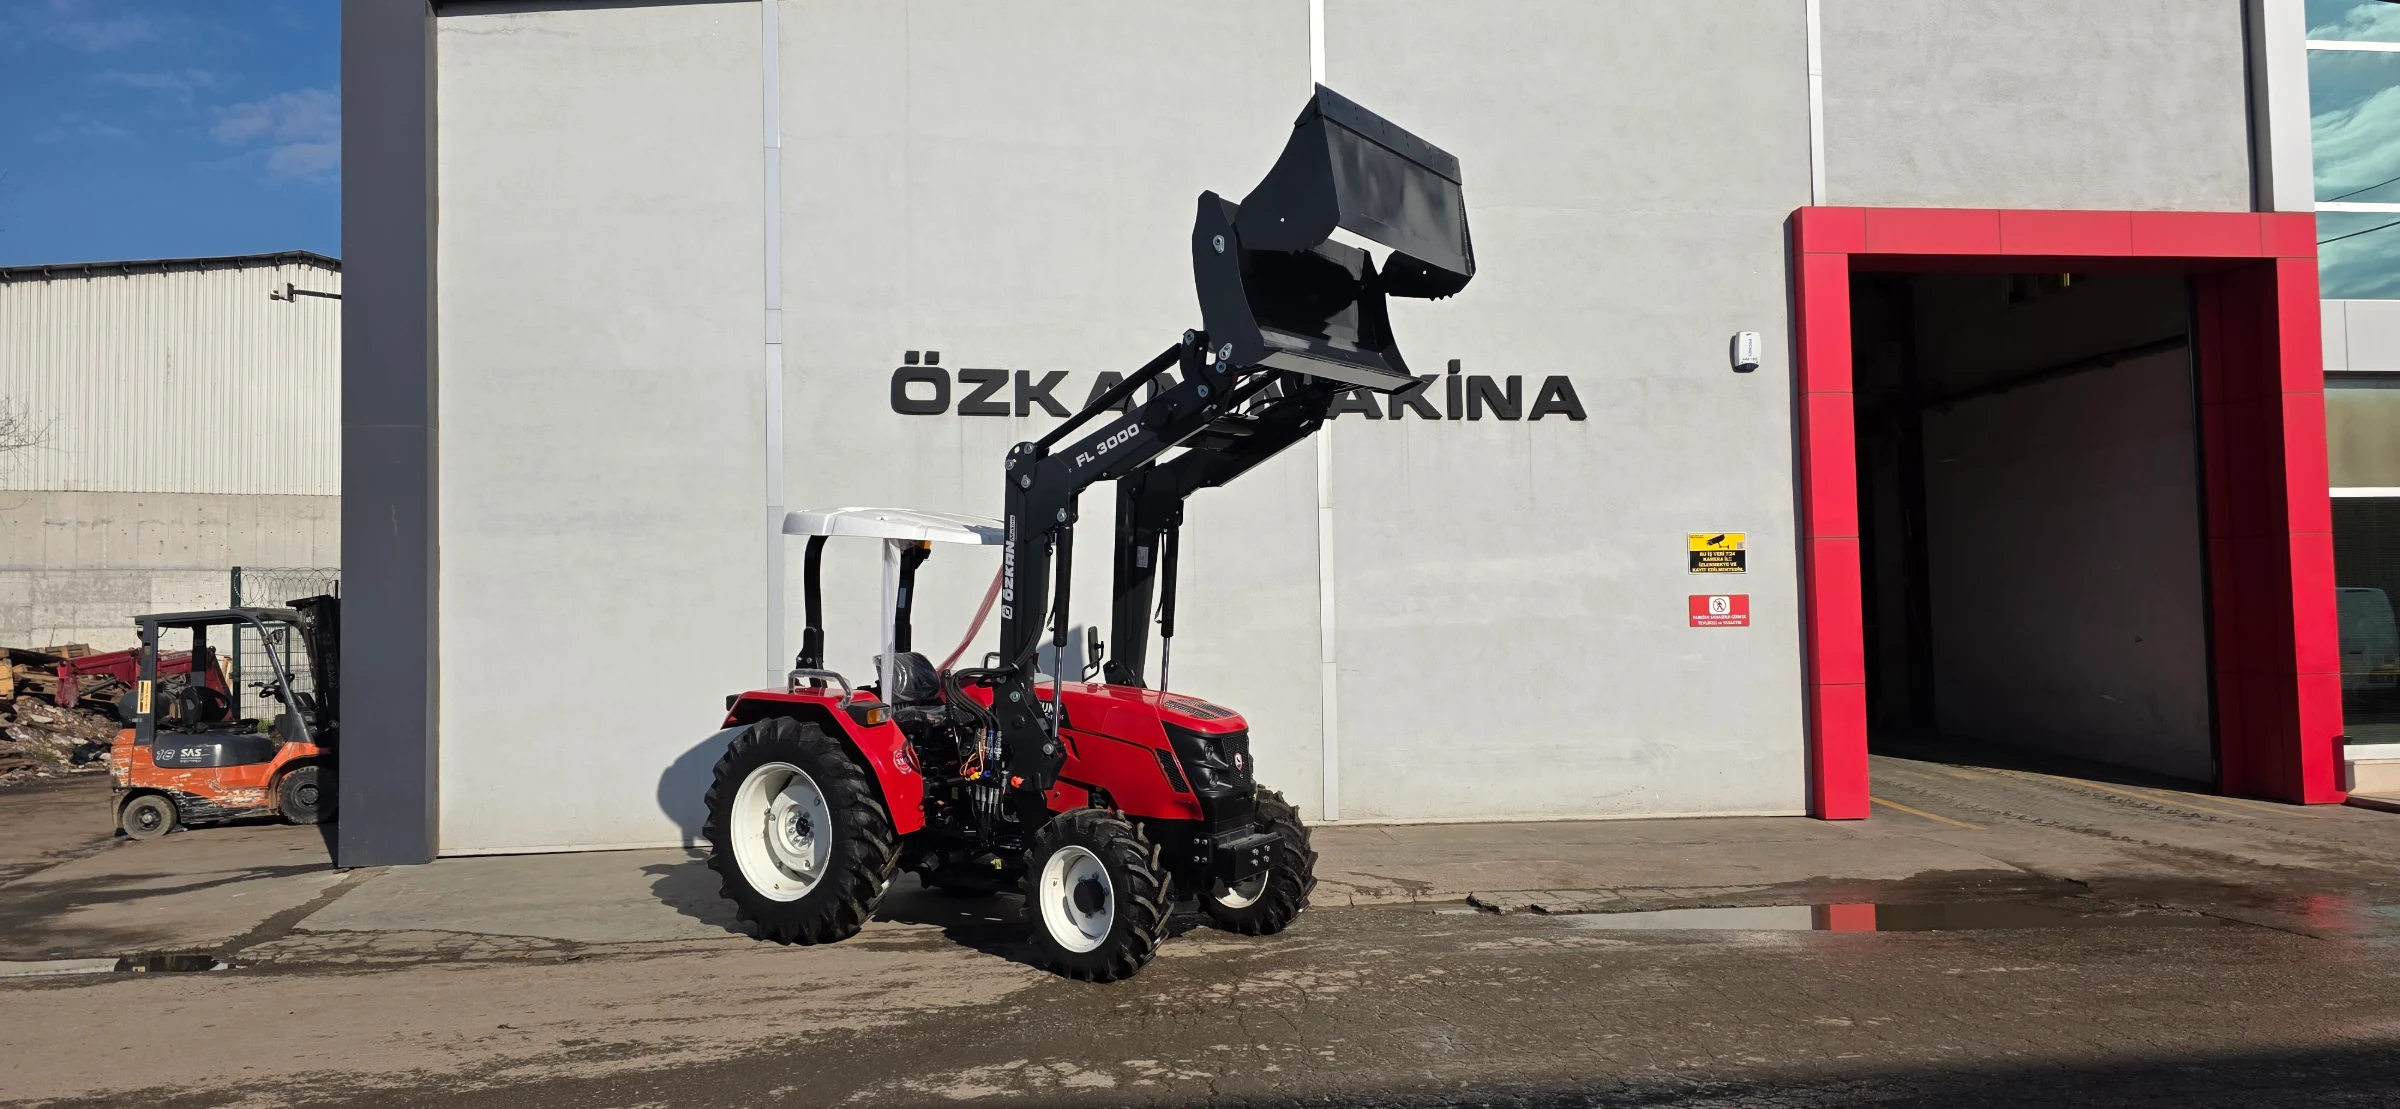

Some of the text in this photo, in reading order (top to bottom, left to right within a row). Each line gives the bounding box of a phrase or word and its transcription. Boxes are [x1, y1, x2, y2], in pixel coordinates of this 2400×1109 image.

[1249, 359, 1587, 421] AKİNA
[1076, 423, 1140, 467] FL 3000
[1003, 540, 1015, 601] ÖZKAN
[156, 749, 175, 760] 18
[181, 748, 202, 757] SAS
